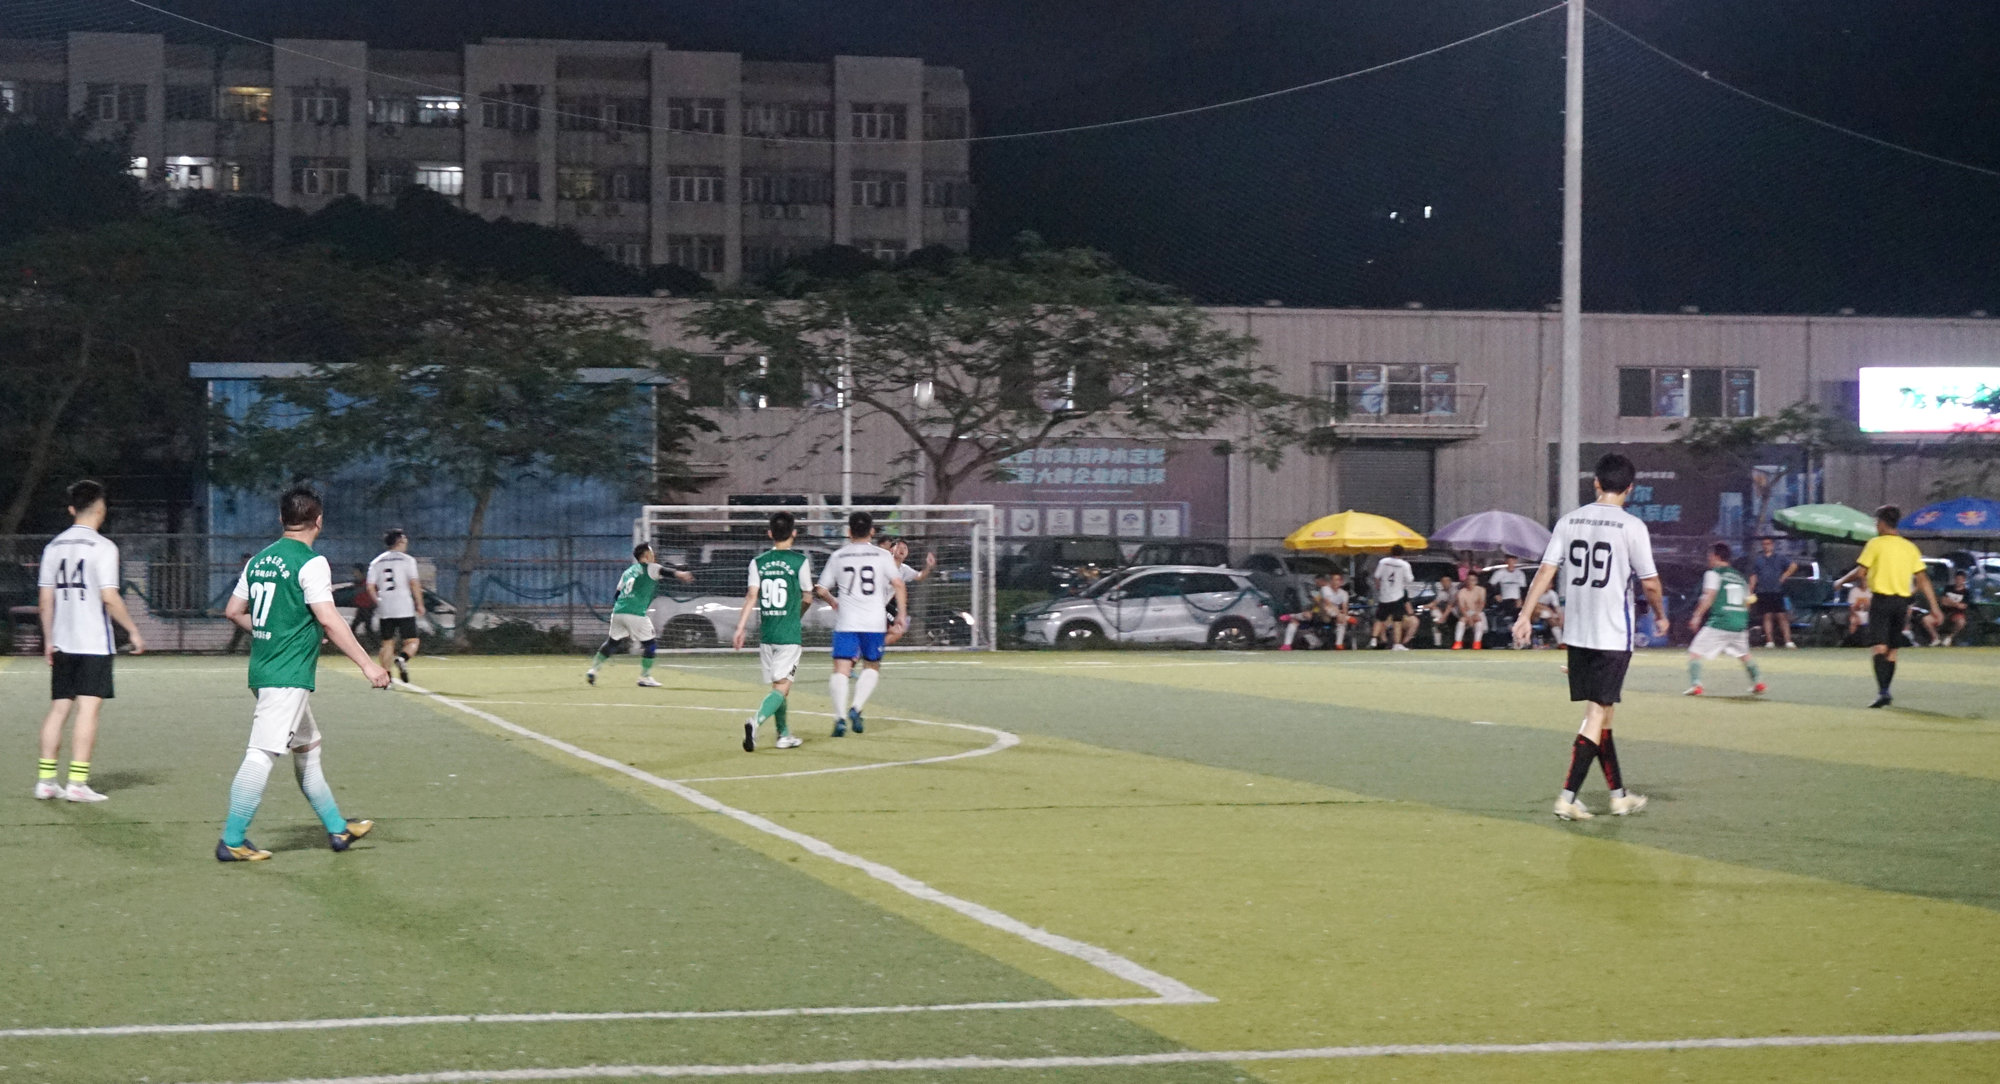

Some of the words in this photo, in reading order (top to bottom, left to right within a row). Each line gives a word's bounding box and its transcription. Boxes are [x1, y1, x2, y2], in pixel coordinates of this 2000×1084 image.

[56, 558, 87, 601] 44
[383, 567, 396, 591] 3
[1387, 571, 1396, 588] 4
[1569, 539, 1613, 589] 99
[760, 577, 788, 609] 96
[843, 566, 875, 596] 78
[250, 581, 277, 627] 27
